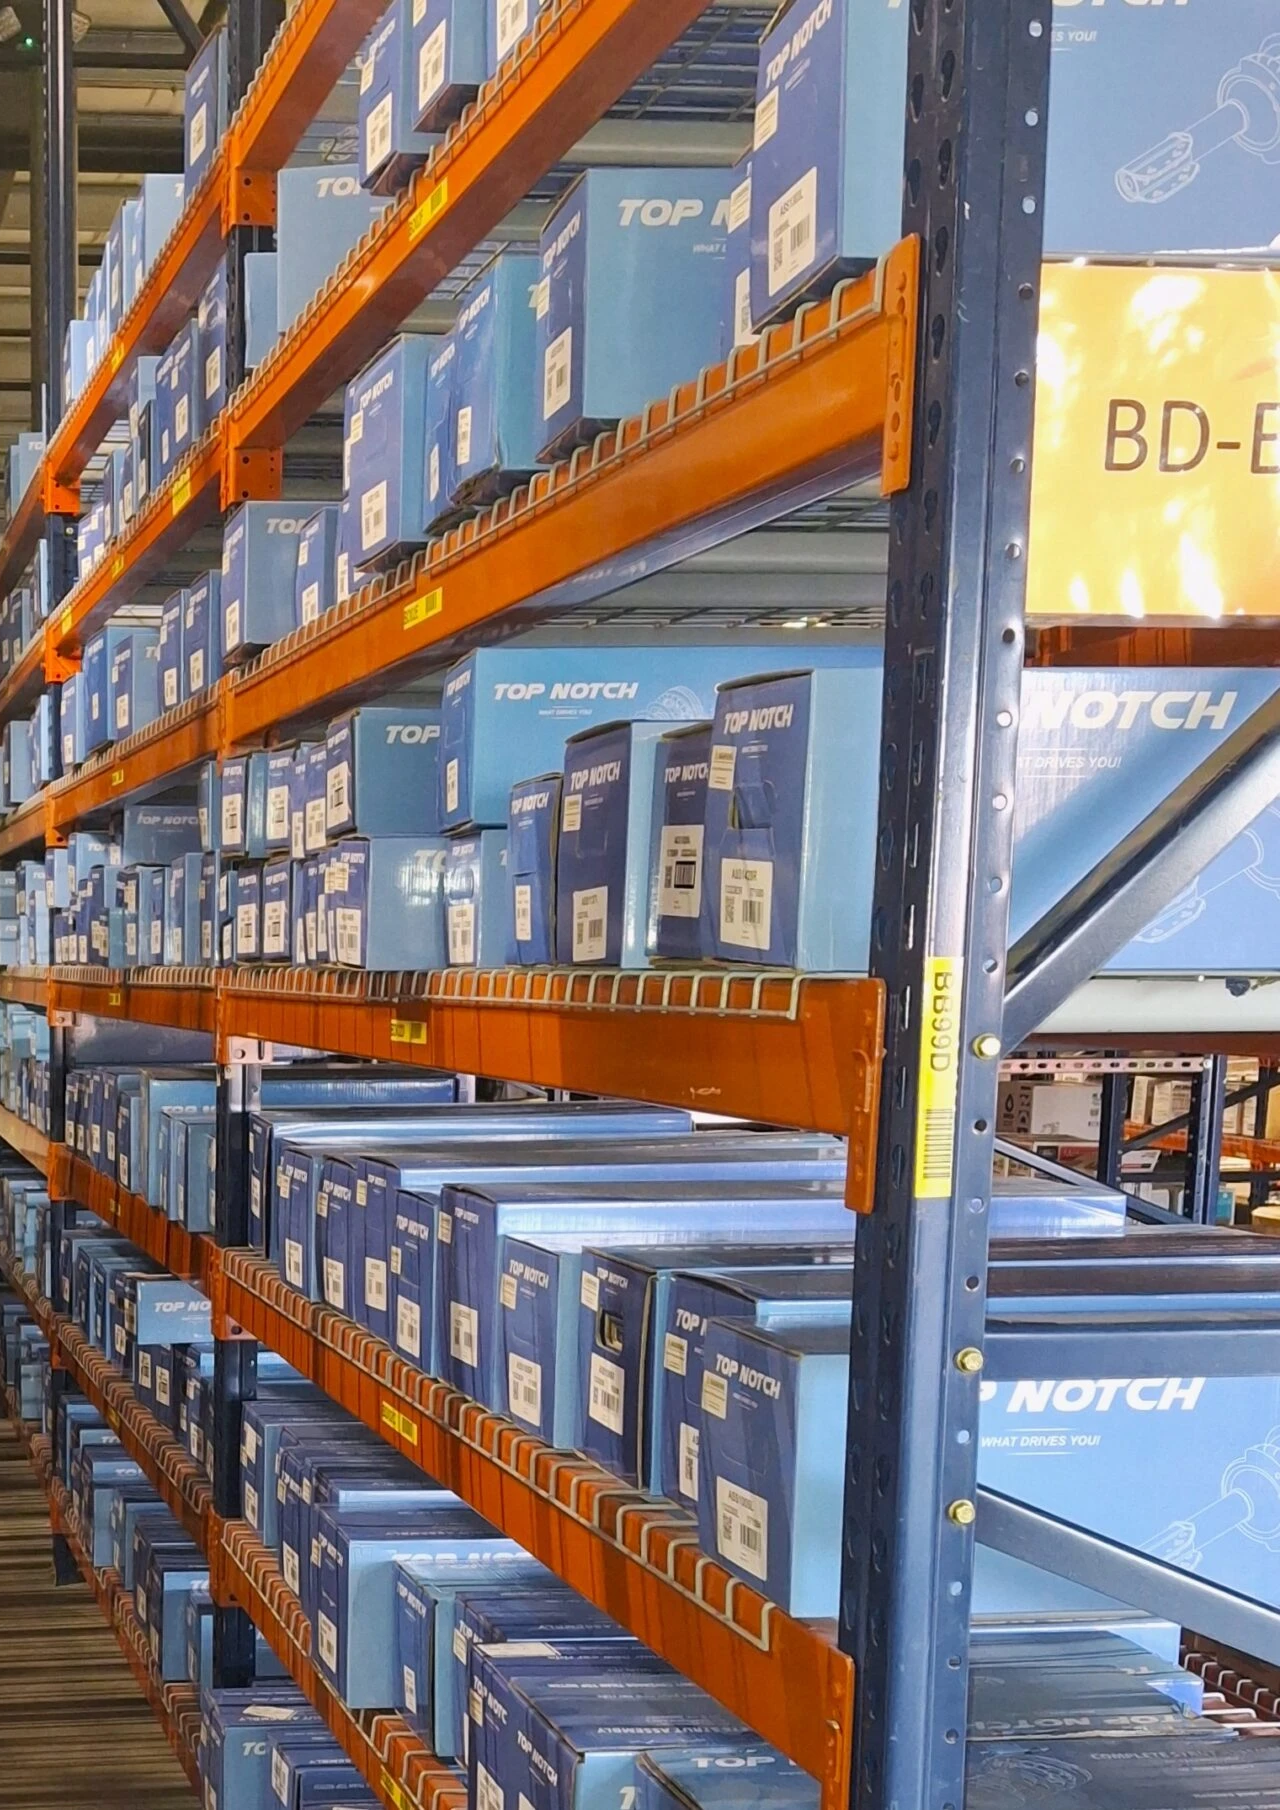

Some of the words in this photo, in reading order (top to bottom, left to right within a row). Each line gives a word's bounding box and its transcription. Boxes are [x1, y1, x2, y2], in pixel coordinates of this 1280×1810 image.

[766, 44, 790, 88] TOP
[790, 0, 832, 61] NOTCH
[618, 199, 704, 226] TOP
[494, 683, 546, 700] TOP
[550, 682, 639, 700] NOTCH
[724, 712, 748, 735] TOP
[749, 703, 793, 732] NOTCH
[570, 770, 590, 791] TOP
[589, 760, 620, 787] NOTCH
[1090, 757, 1122, 769] YOU!
[511, 797, 522, 815] TOP
[521, 791, 549, 812] NOTCH
[929, 971, 954, 1072] BB99D
[509, 1260, 523, 1277] TOP
[523, 1266, 549, 1289] NOTCH
[154, 1302, 185, 1313] TOP
[676, 1309, 700, 1331] TOP
[716, 1353, 740, 1376] TOP
[739, 1365, 781, 1400] NOTCH
[1006, 1376, 1207, 1413] NOTCH
[981, 1436, 1018, 1448] WHAT
[1020, 1435, 1067, 1447] DRIVES
[1070, 1435, 1101, 1447] YOU!
[473, 1675, 487, 1698] TOP
[487, 1695, 508, 1725] NOTC
[517, 1730, 532, 1753] TOP
[532, 1750, 558, 1787] NOTCH
[691, 1757, 775, 1768] TOP
